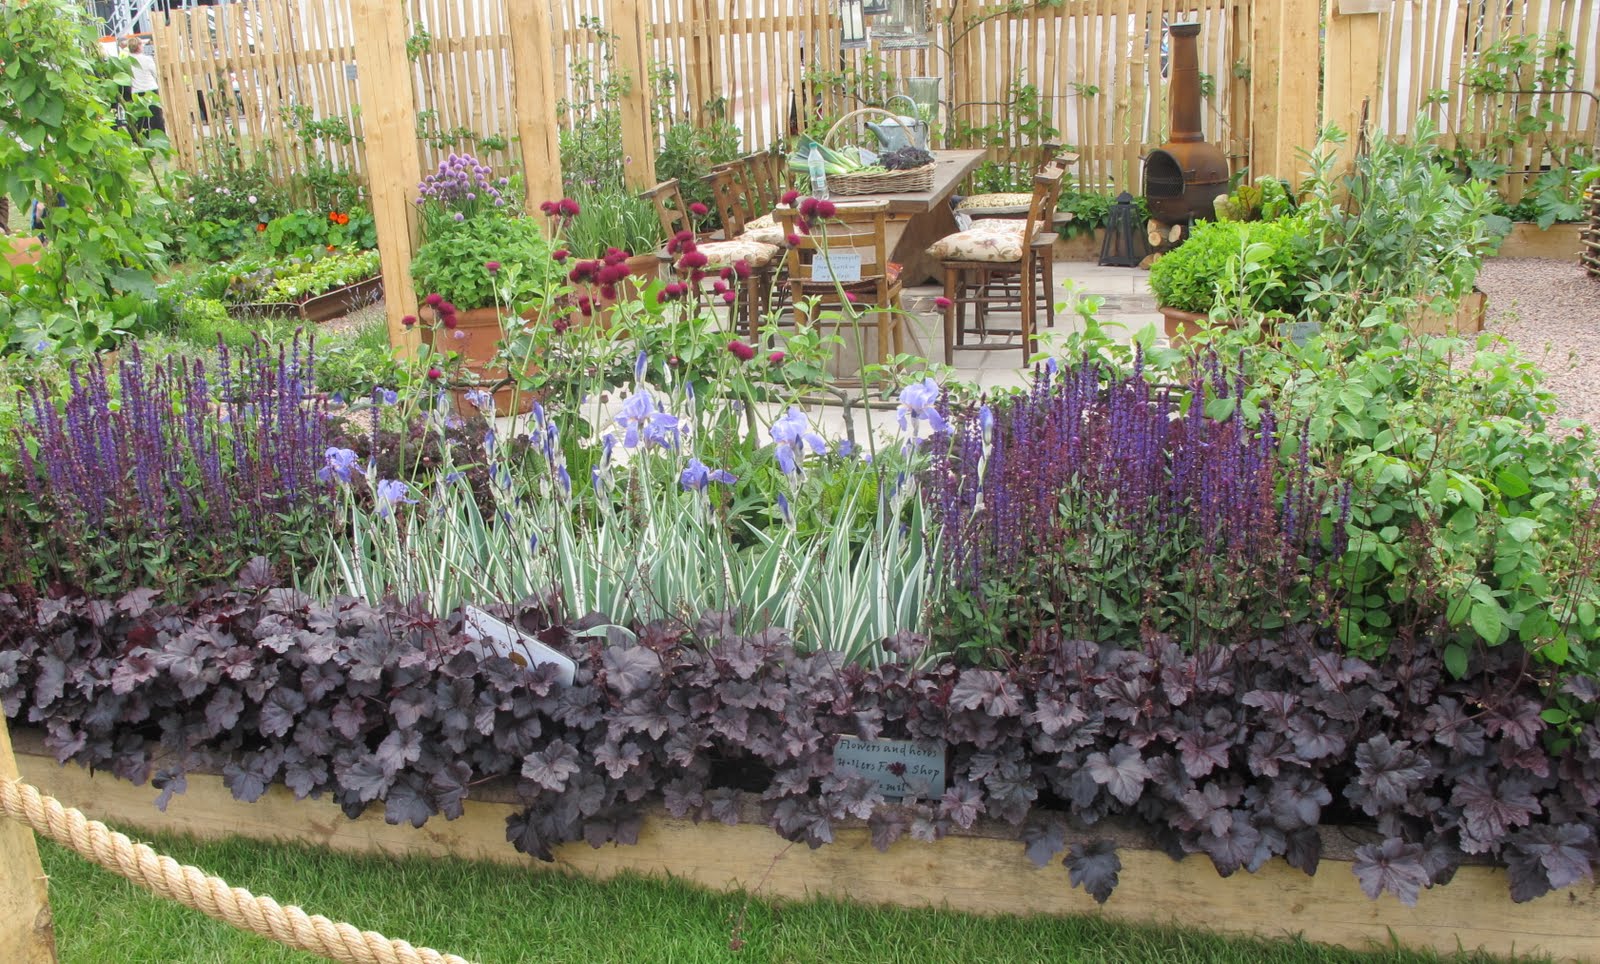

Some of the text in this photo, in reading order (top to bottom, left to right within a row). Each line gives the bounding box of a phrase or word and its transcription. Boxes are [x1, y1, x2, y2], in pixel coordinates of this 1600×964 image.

[840, 739, 881, 752] Flowers
[883, 744, 906, 756] and
[911, 764, 940, 783] Shop
